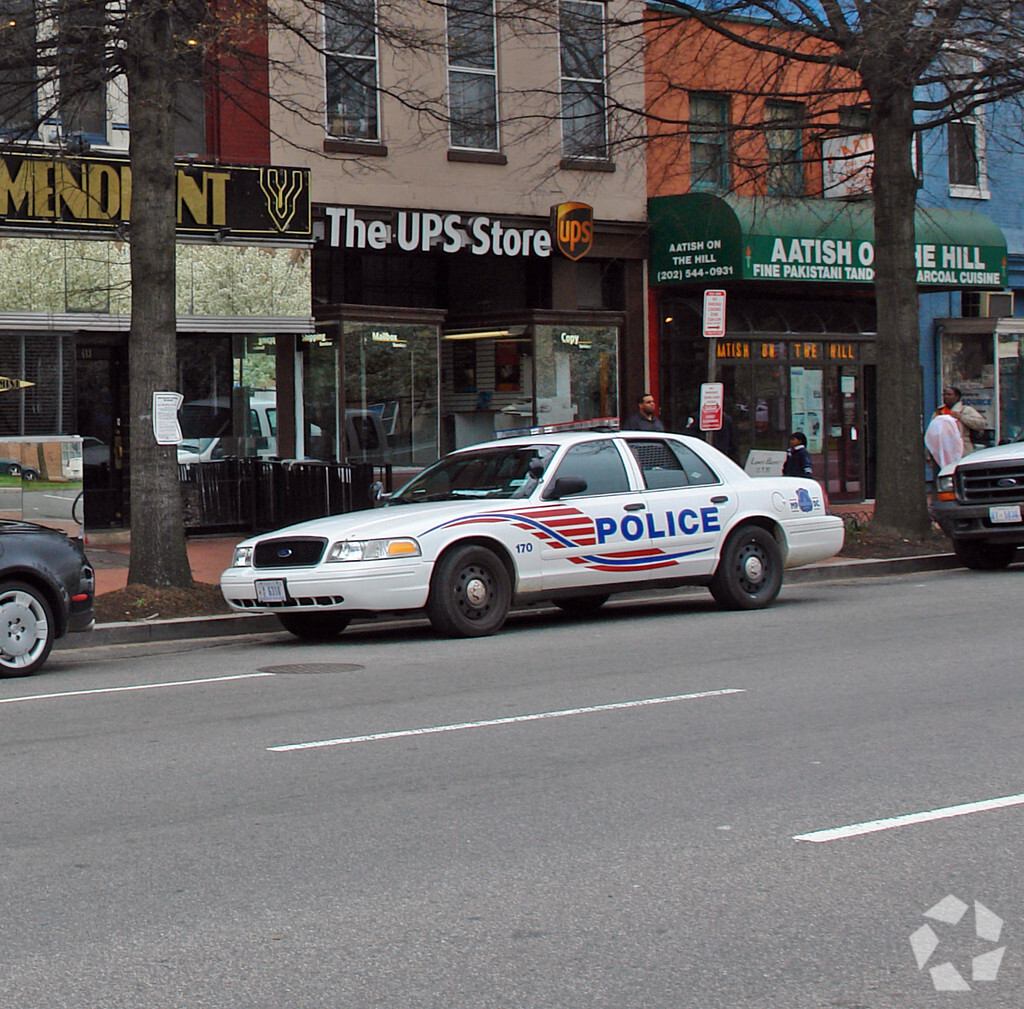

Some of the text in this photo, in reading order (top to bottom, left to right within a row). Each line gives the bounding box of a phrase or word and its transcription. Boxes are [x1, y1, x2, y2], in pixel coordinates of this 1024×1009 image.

[326, 207, 552, 257] The UPS Store
[559, 220, 591, 251] ups
[669, 240, 722, 253] AATISH ON
[771, 238, 986, 270] AATISH O HE HILL
[672, 254, 717, 266] THE HILL
[657, 266, 733, 282] (202) 544-0931
[753, 263, 1001, 285] FINE PAKISTANI TAND ARCOAL CUISINE
[560, 332, 580, 345] Copy
[761, 343, 775, 358] ON
[794, 343, 818, 359] THE
[829, 343, 855, 359] HILL
[595, 506, 721, 544] POLICE
[516, 542, 533, 554] 170
